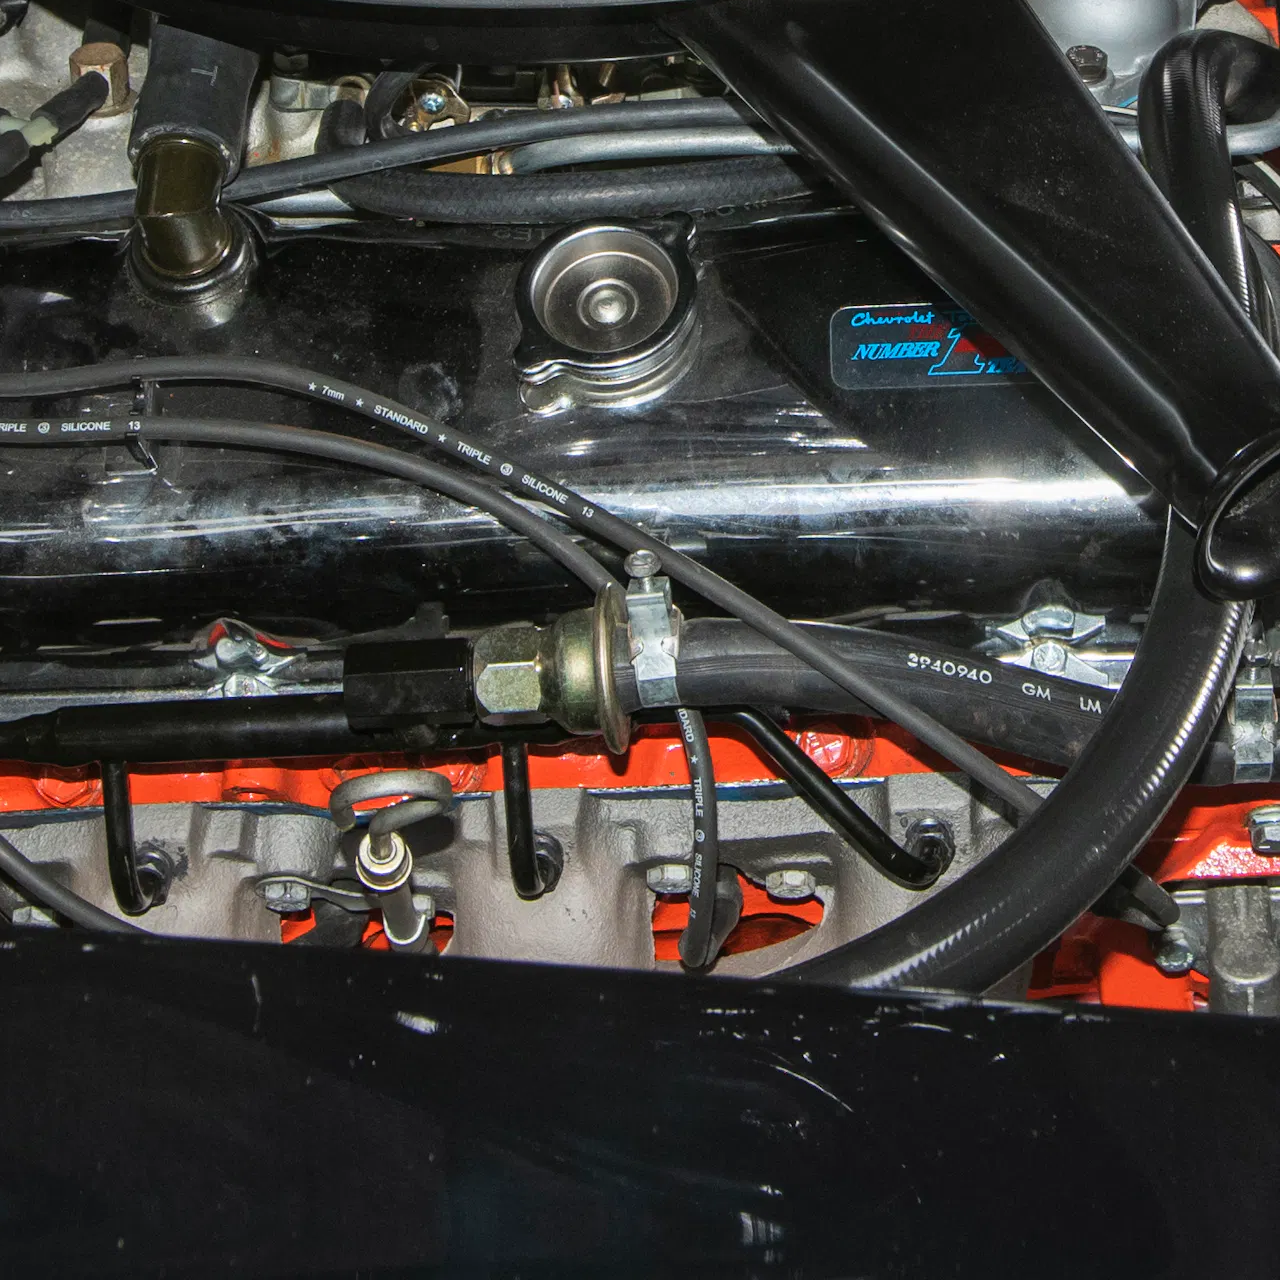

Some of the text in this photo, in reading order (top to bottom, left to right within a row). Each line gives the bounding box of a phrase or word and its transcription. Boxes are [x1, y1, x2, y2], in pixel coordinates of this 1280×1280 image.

[851, 311, 935, 327] Chevrolet
[851, 340, 941, 361] NUMBER
[60, 420, 111, 432] SILICONE
[128, 419, 141, 431] 13
[321, 385, 346, 401] 7mm
[373, 403, 429, 435] STANDARD
[456, 440, 492, 466] TRIPLE
[521, 474, 569, 505] SILICONE
[581, 505, 594, 519] 13
[1021, 682, 1051, 701] GM
[1079, 696, 1102, 714] LM
[692, 777, 704, 818] TRIPLE
[691, 852, 703, 898] SILICONE
